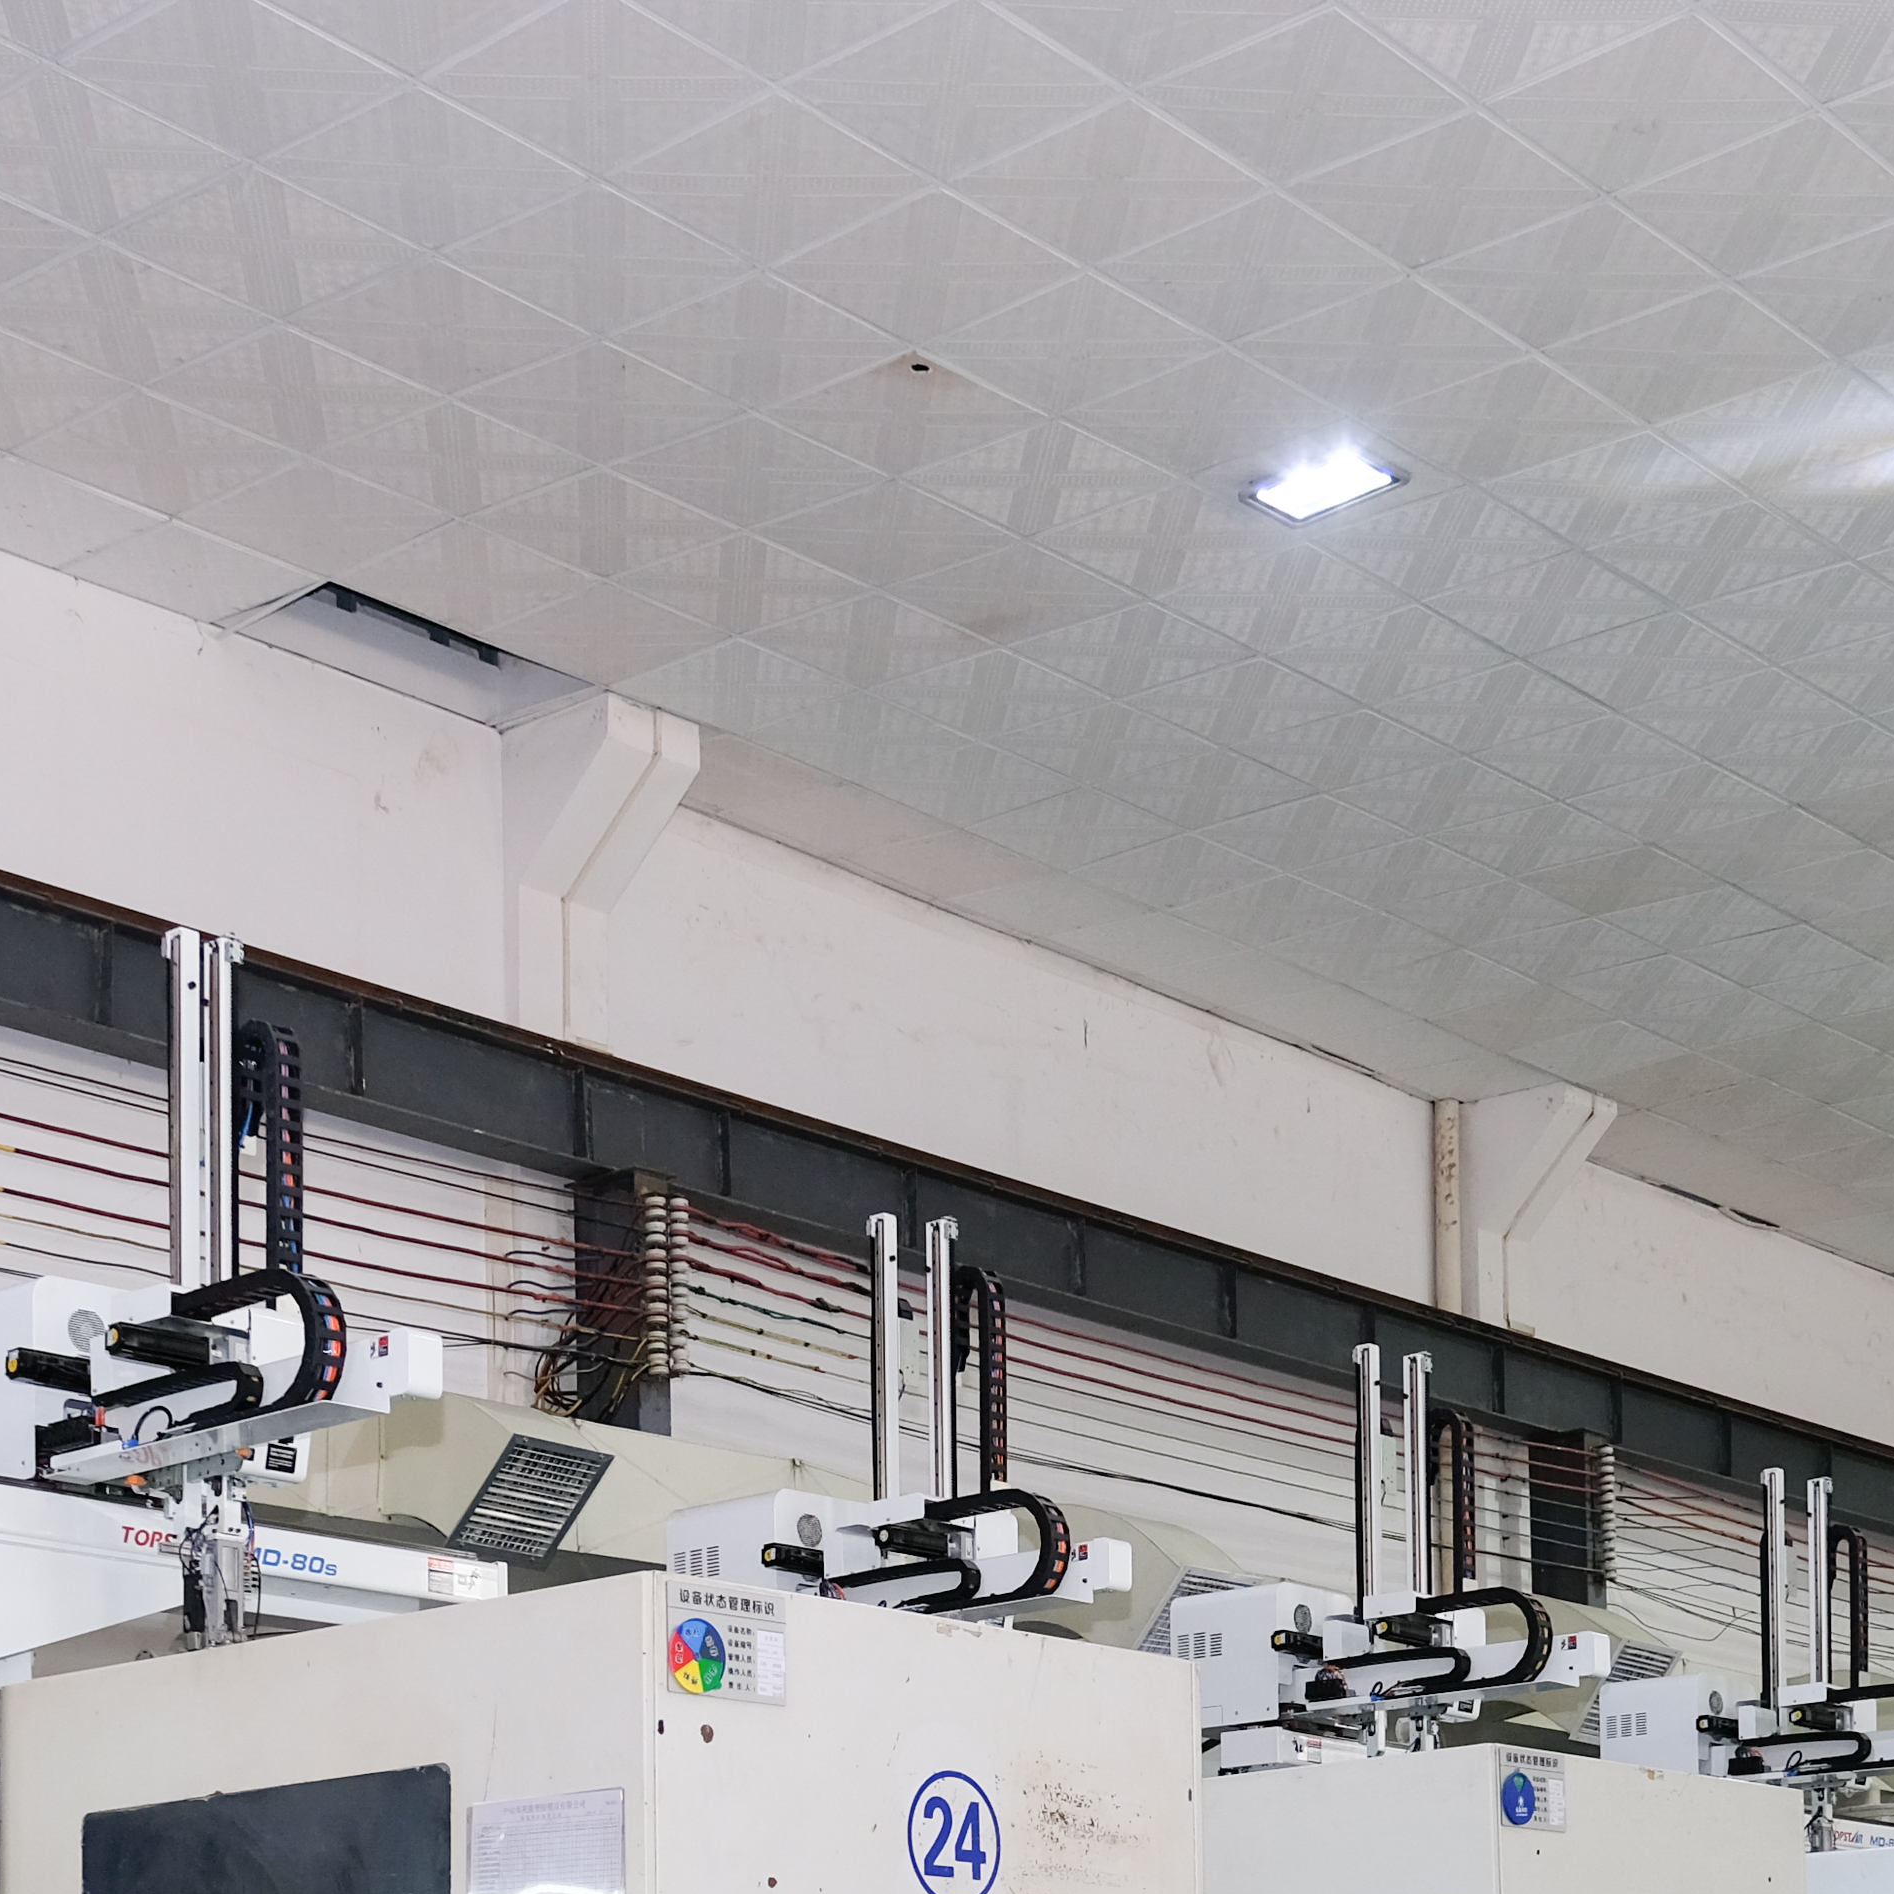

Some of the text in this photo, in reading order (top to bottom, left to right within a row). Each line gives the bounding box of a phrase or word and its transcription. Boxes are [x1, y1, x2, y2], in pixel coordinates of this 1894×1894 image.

[679, 1587, 775, 1617] 设备状态管理标识
[922, 1796, 987, 1881] 24
